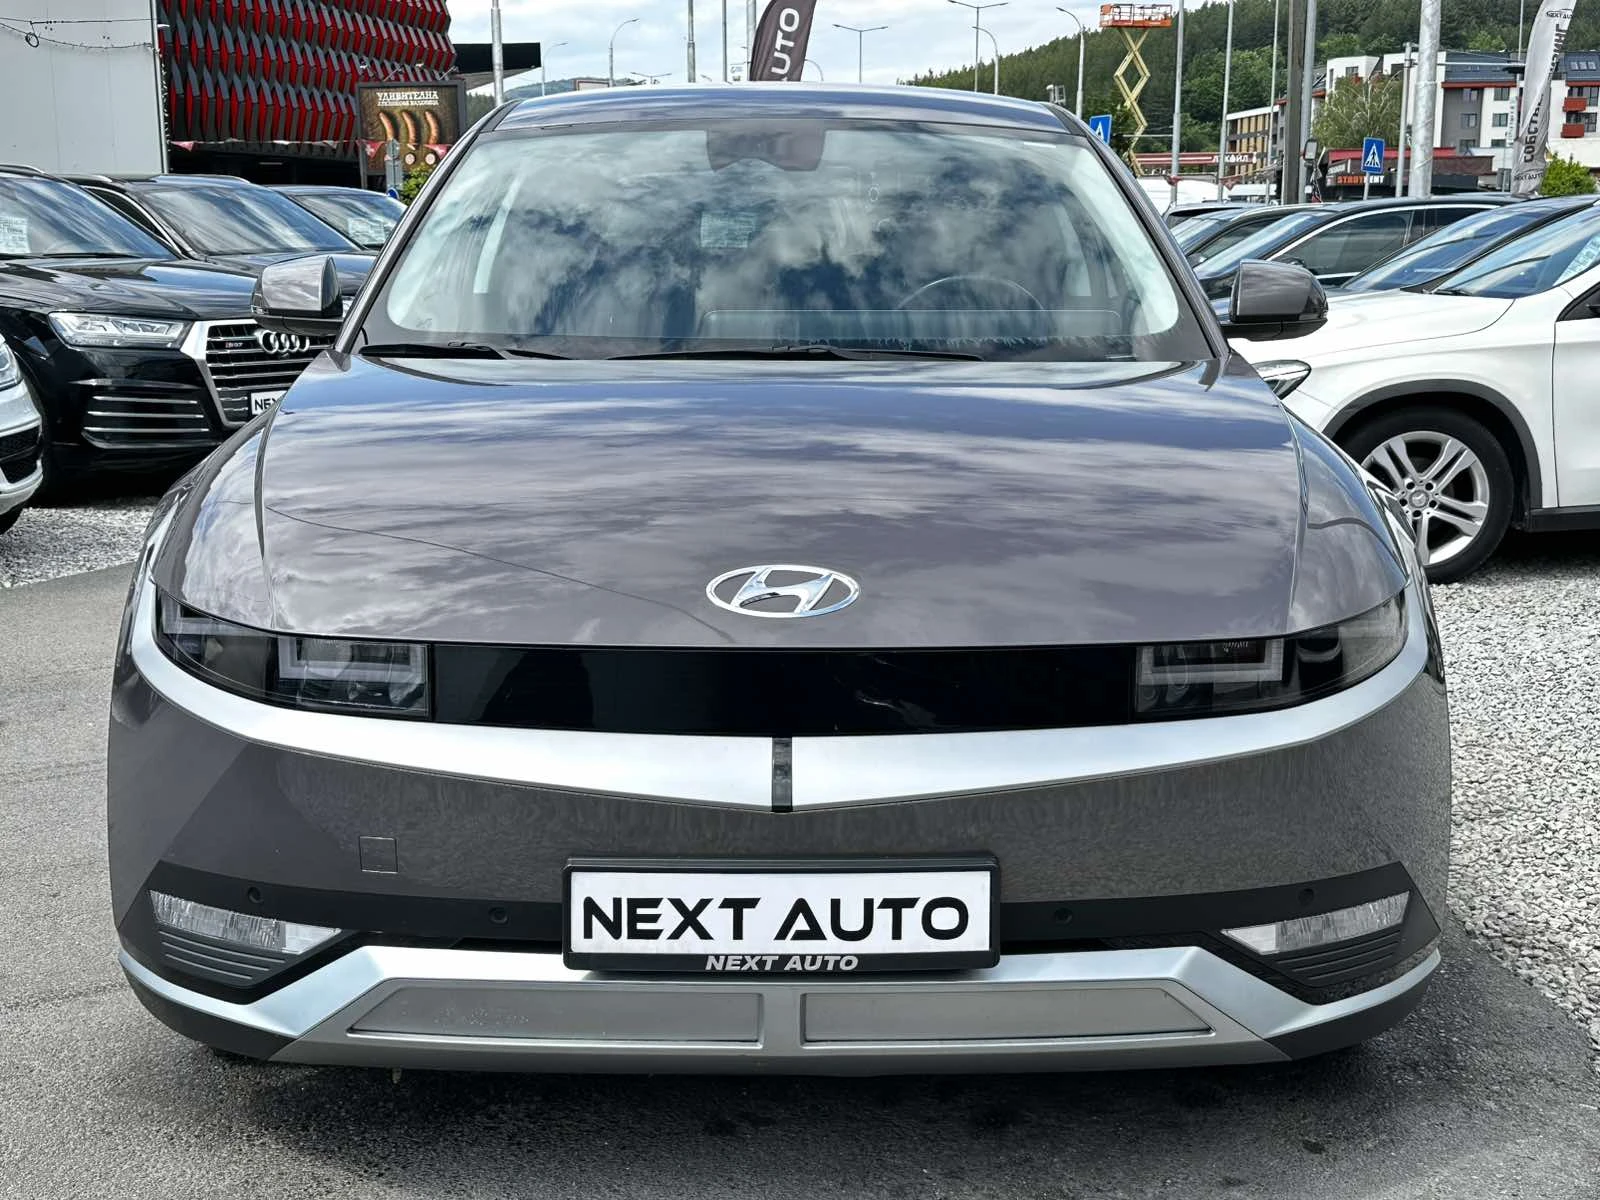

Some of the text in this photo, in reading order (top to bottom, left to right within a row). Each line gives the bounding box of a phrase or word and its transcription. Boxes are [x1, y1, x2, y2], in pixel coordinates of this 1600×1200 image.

[771, 8, 800, 81] UTO
[1213, 153, 1249, 163] ЛКОЙЛ
[583, 896, 970, 942] NEXT AUTO
[705, 954, 860, 972] NEXT AUTO
